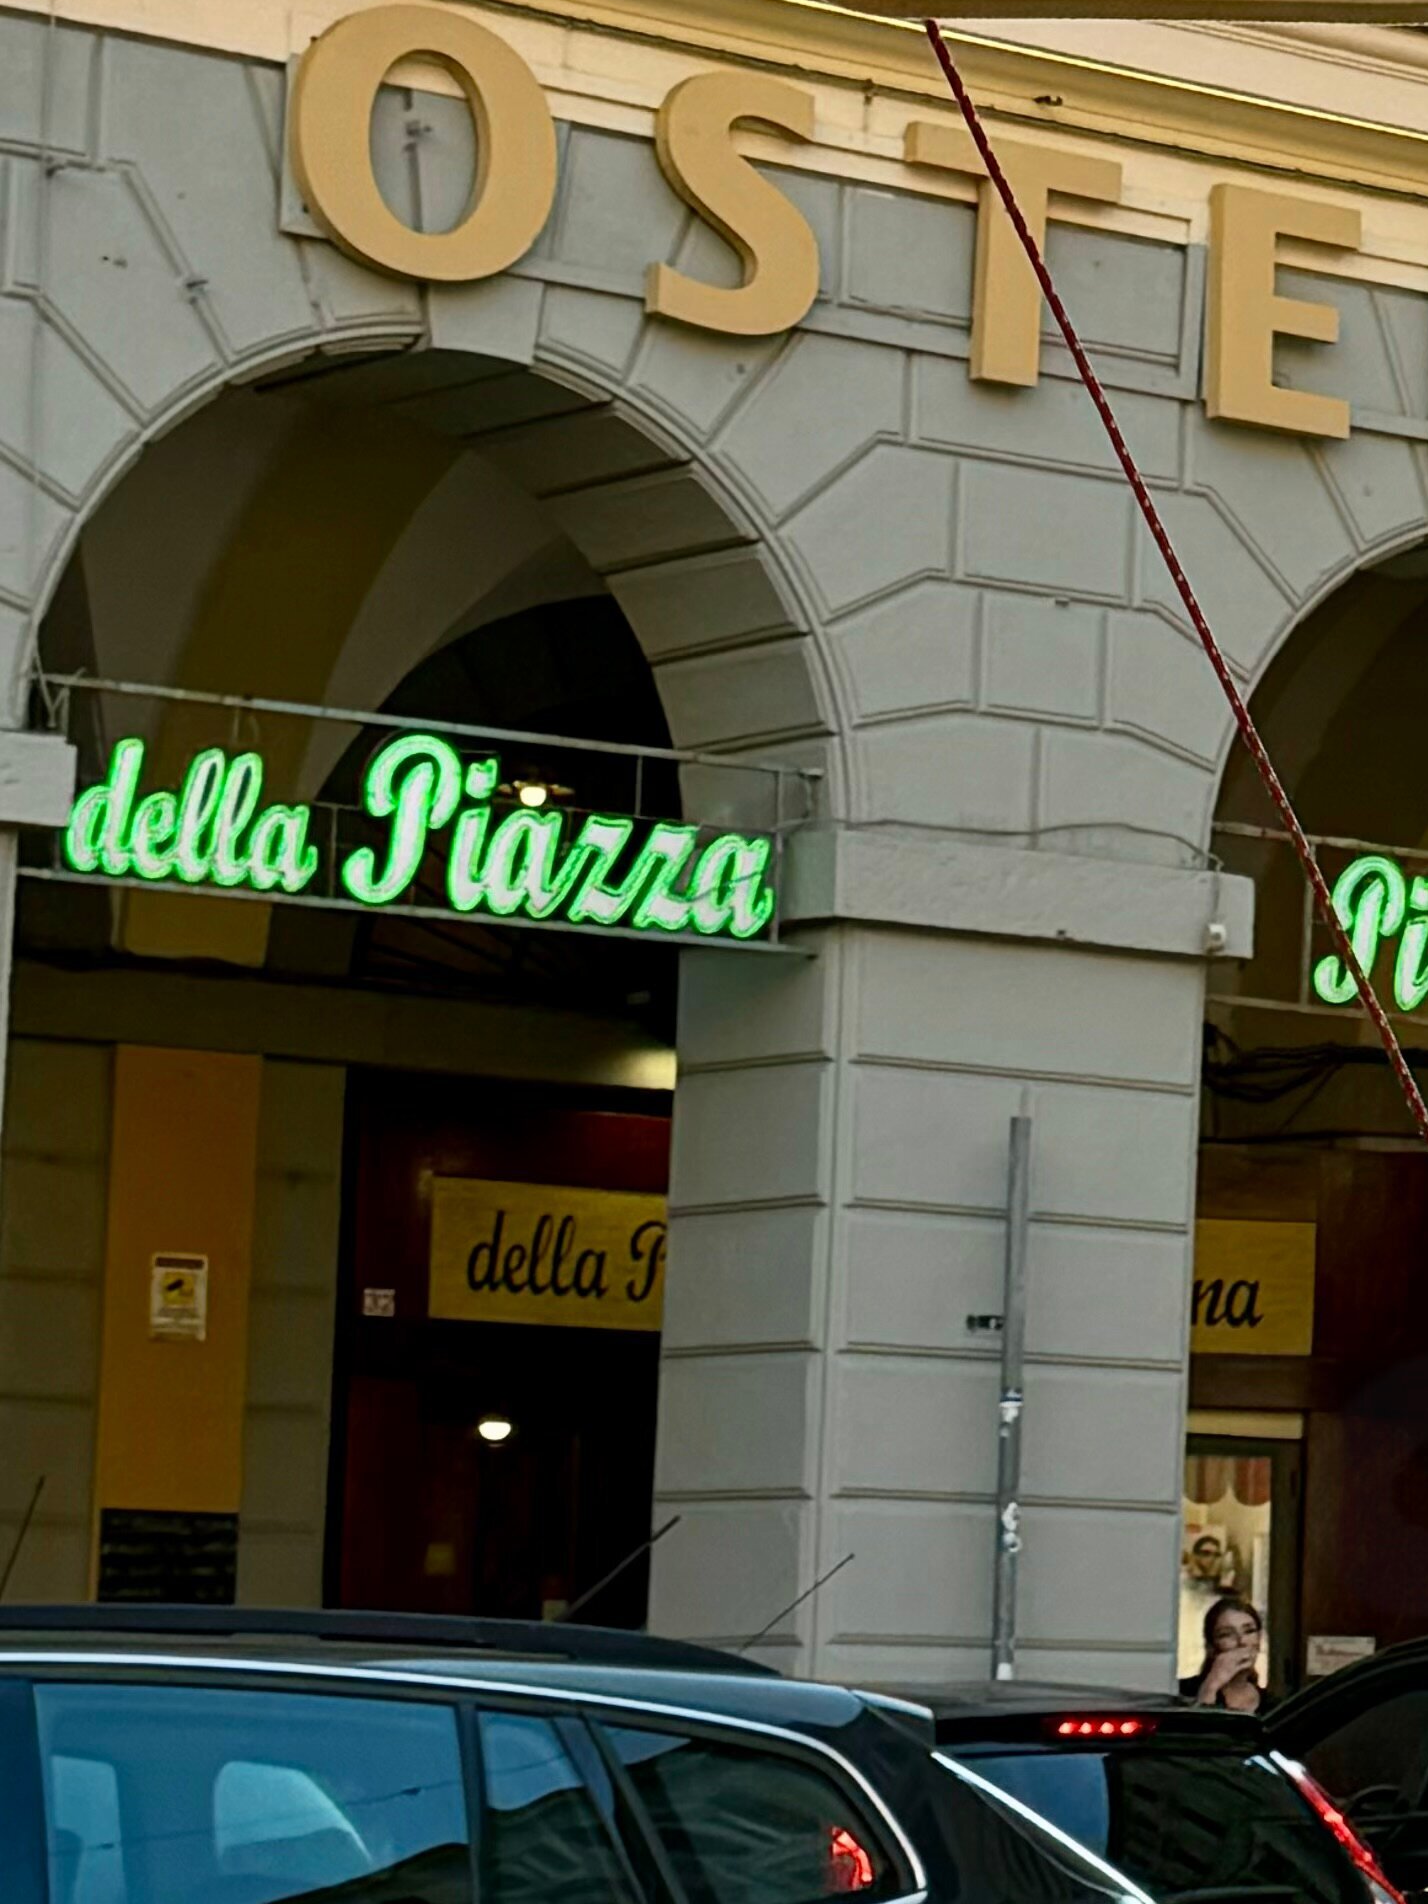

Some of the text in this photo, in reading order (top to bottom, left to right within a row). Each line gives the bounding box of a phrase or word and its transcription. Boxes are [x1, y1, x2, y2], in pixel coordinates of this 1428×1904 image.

[65, 730, 775, 939] della Piazza
[467, 1210, 607, 1299] della
